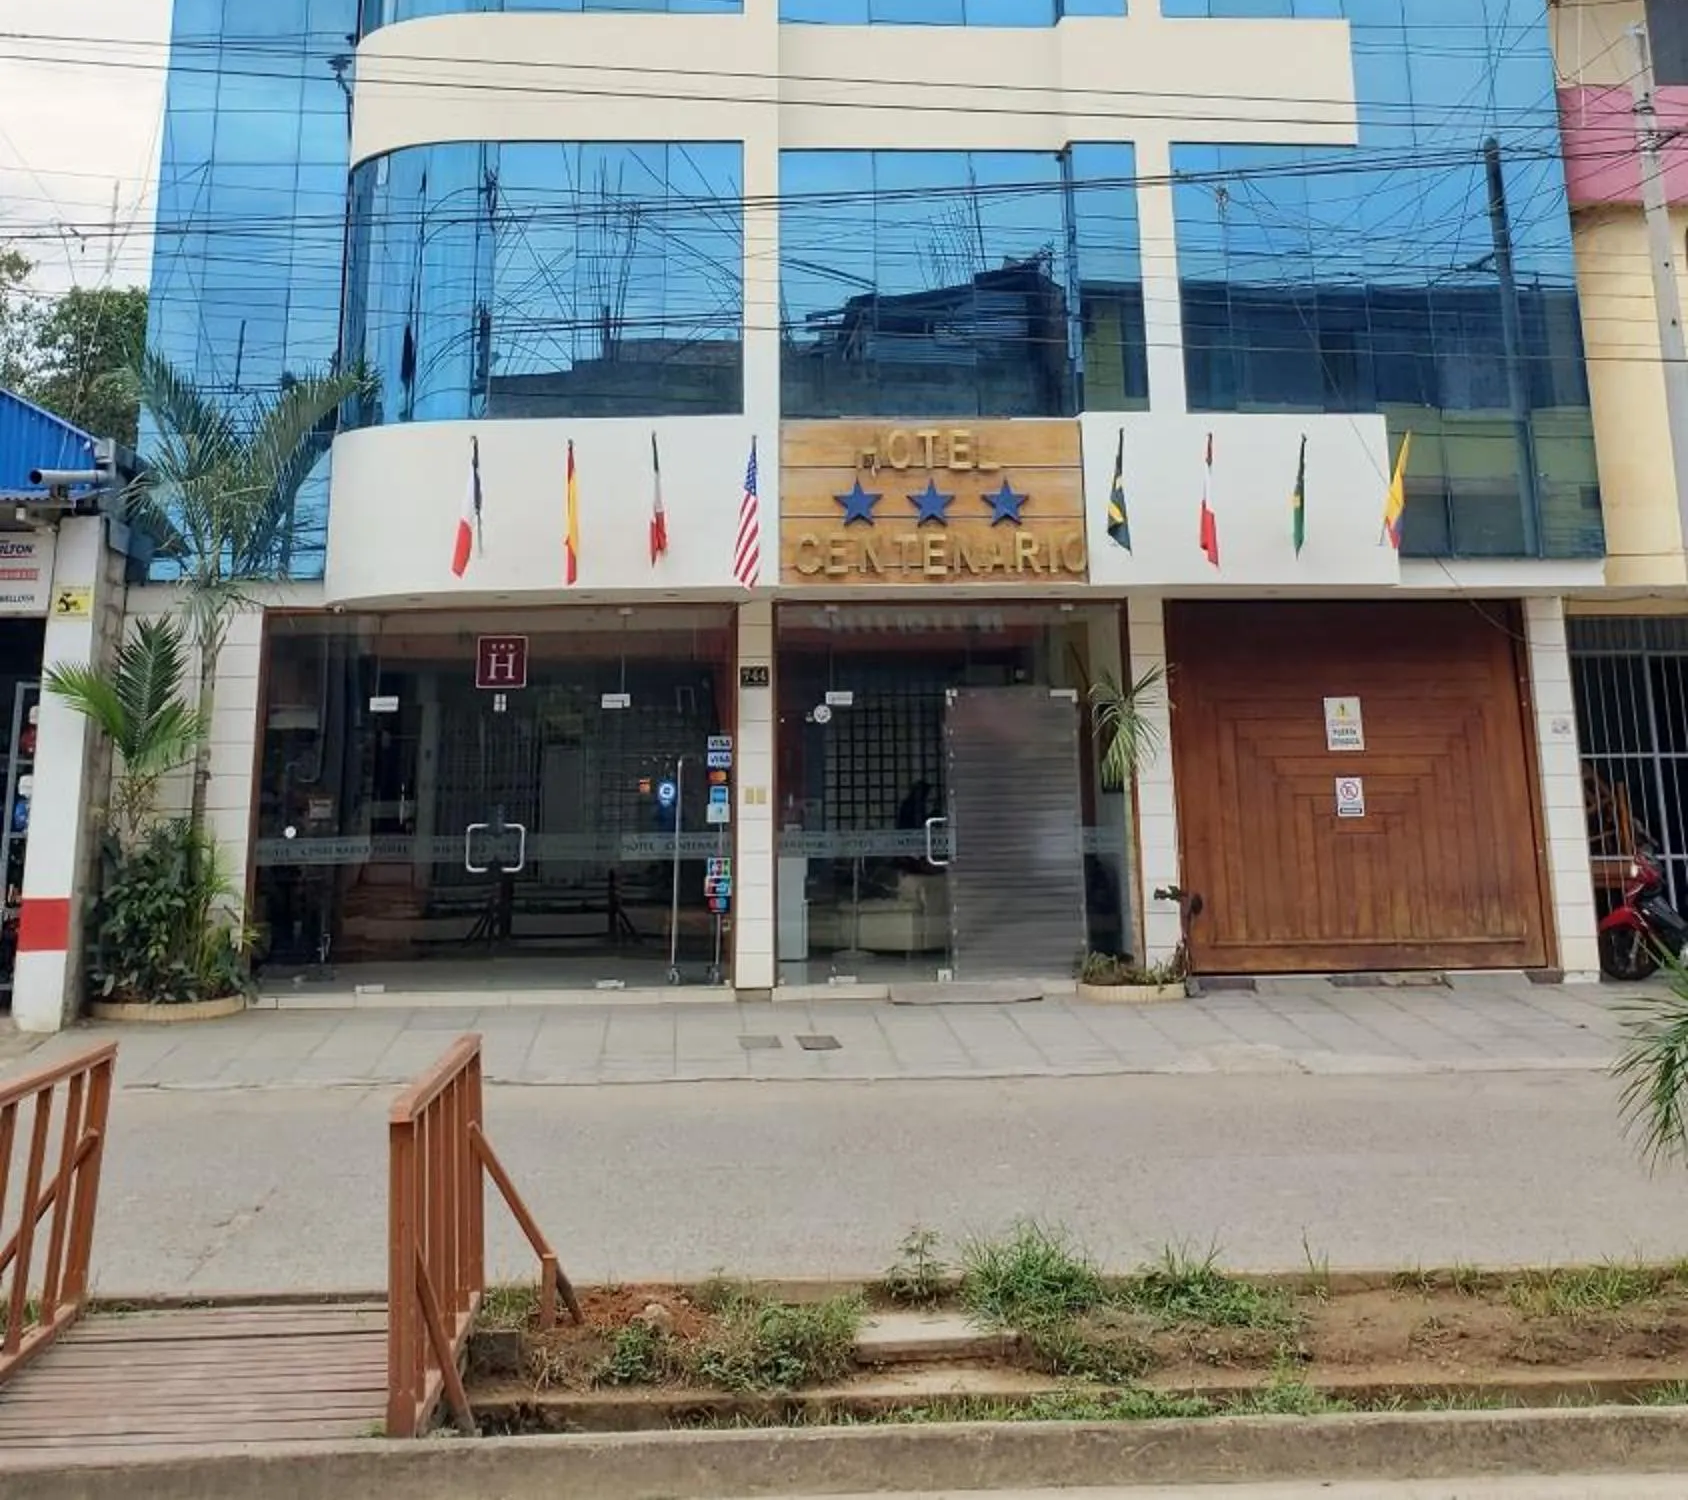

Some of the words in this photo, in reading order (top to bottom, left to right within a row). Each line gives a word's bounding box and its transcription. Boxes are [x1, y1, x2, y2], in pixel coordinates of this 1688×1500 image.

[854, 428, 1001, 473] HOTEL
[795, 530, 1089, 577] CENTENARIO
[487, 653, 515, 680] H
